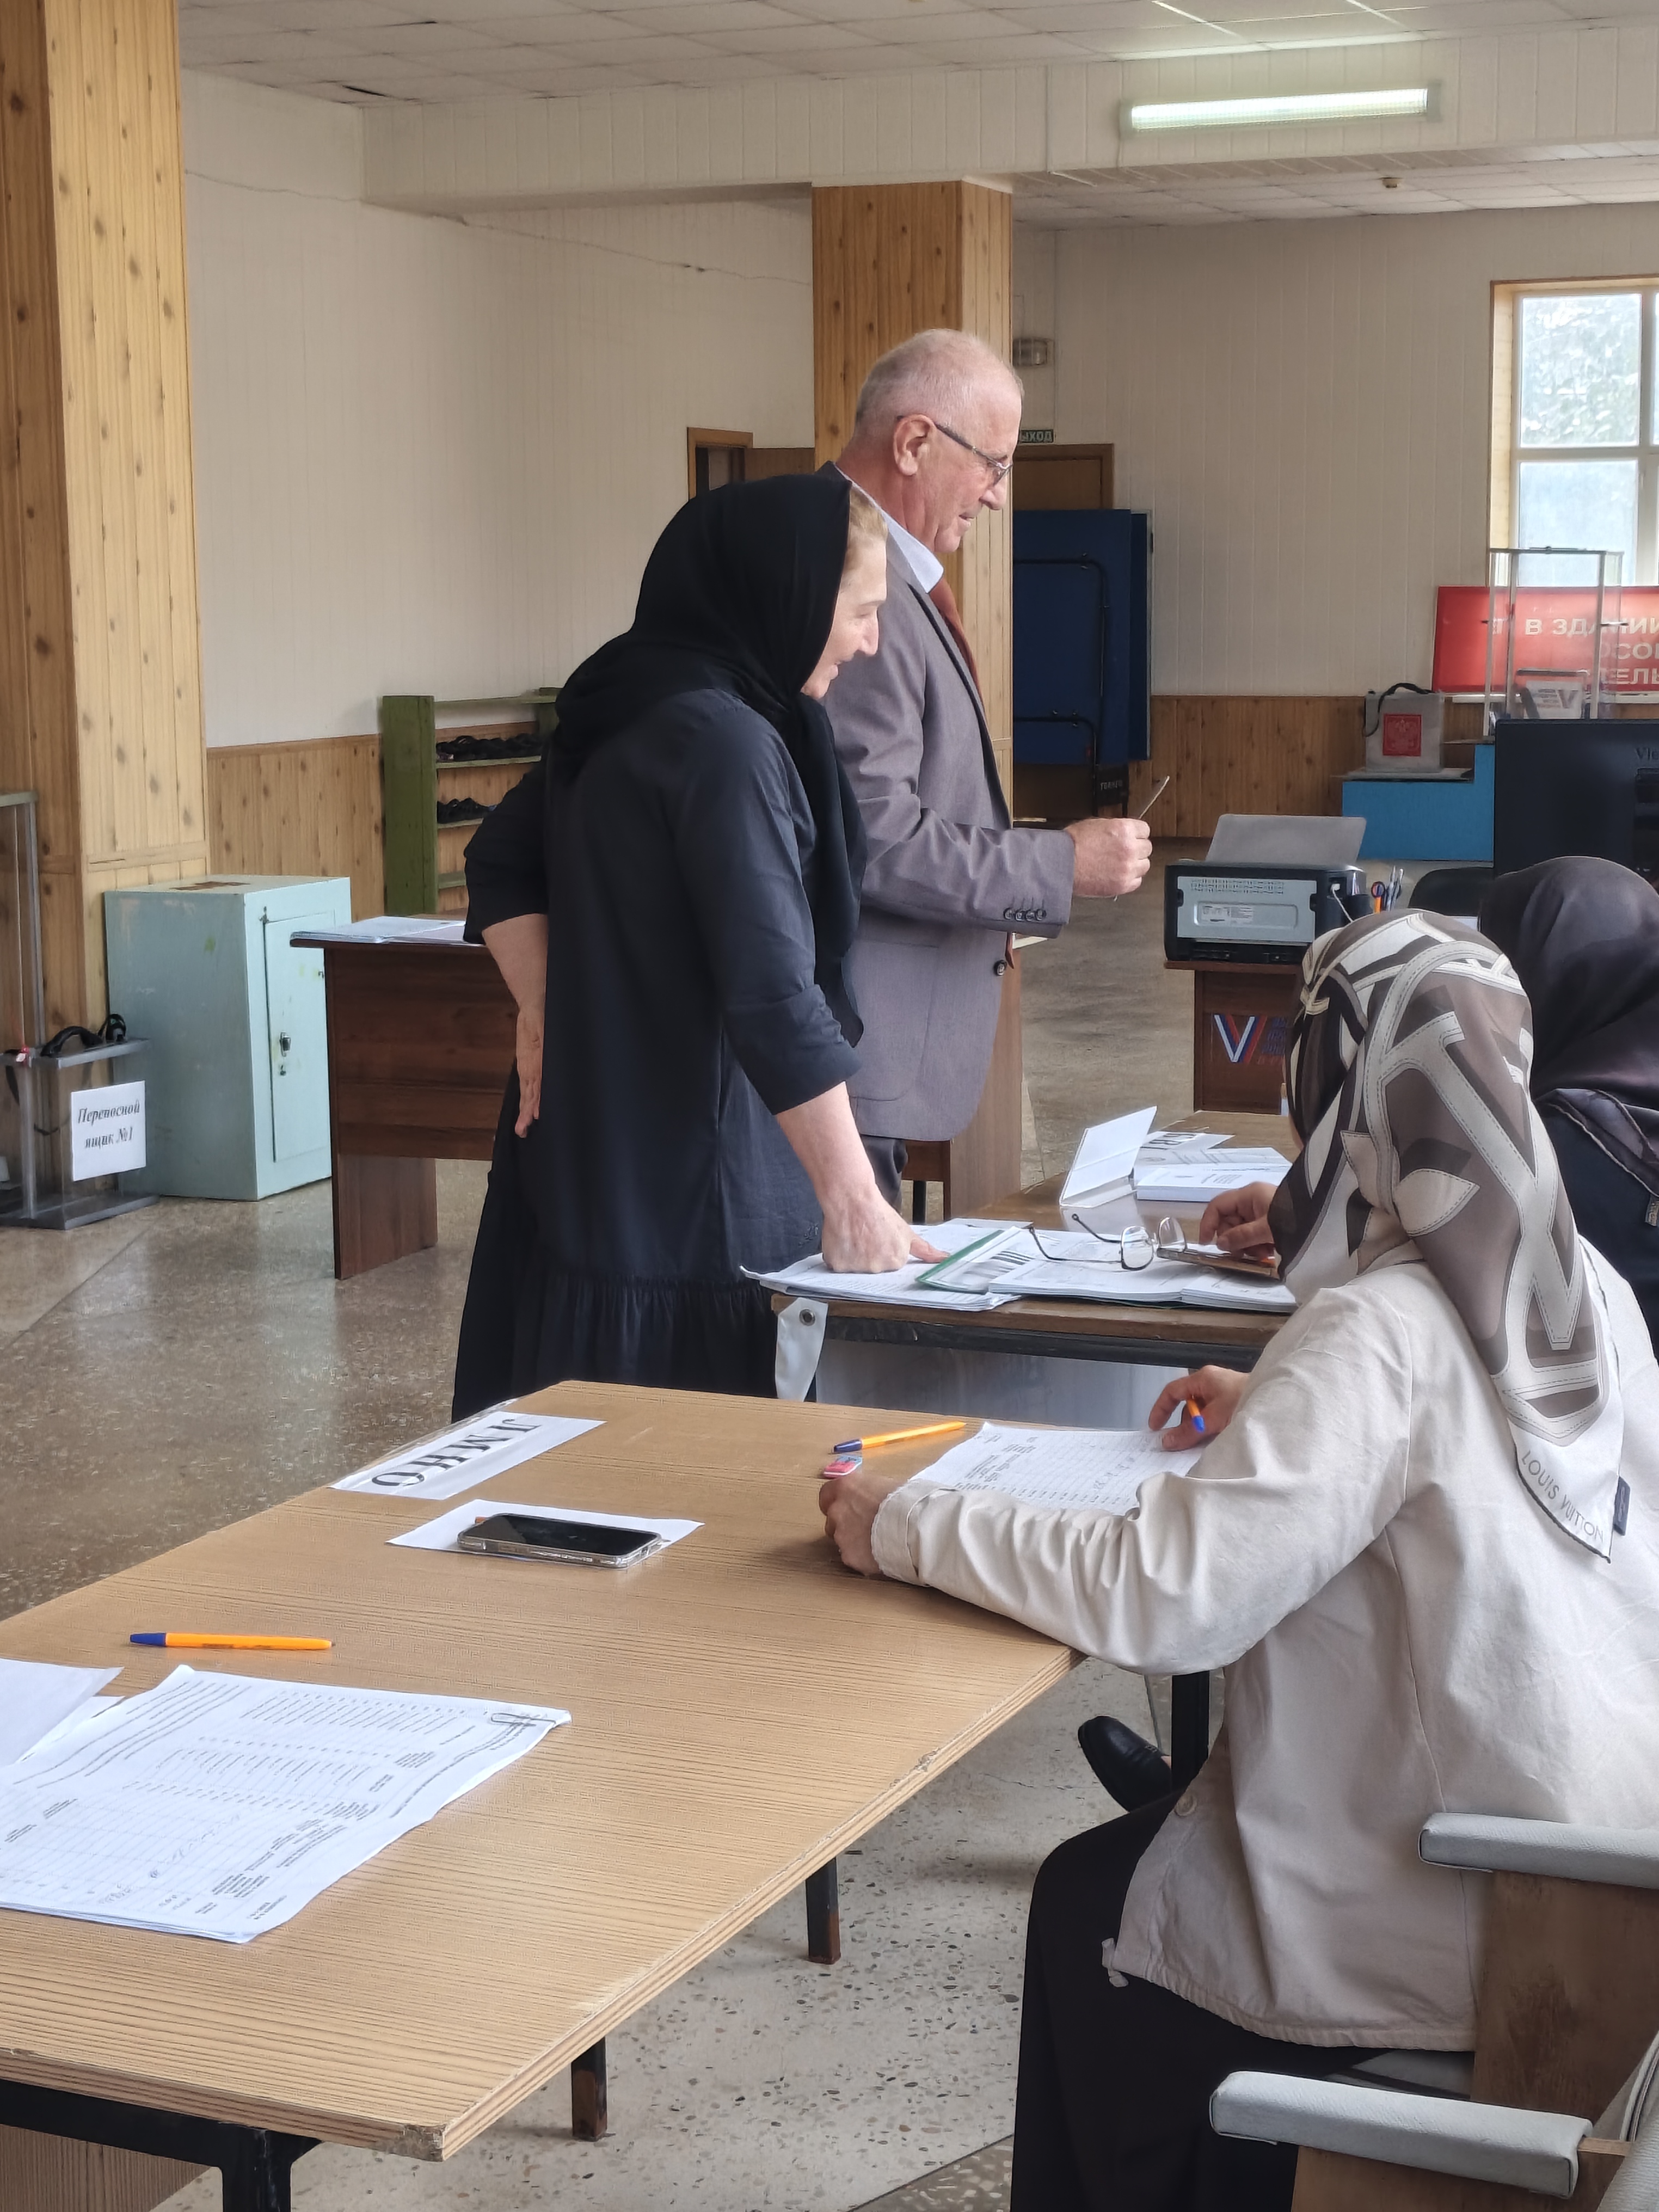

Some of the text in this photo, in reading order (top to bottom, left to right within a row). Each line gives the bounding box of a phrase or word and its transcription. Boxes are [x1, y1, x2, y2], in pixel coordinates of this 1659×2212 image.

[1525, 618, 1542, 635] В
[78, 1099, 140, 1126] Переносной
[1521, 1450, 1603, 1543] LOUIS VUITTON
